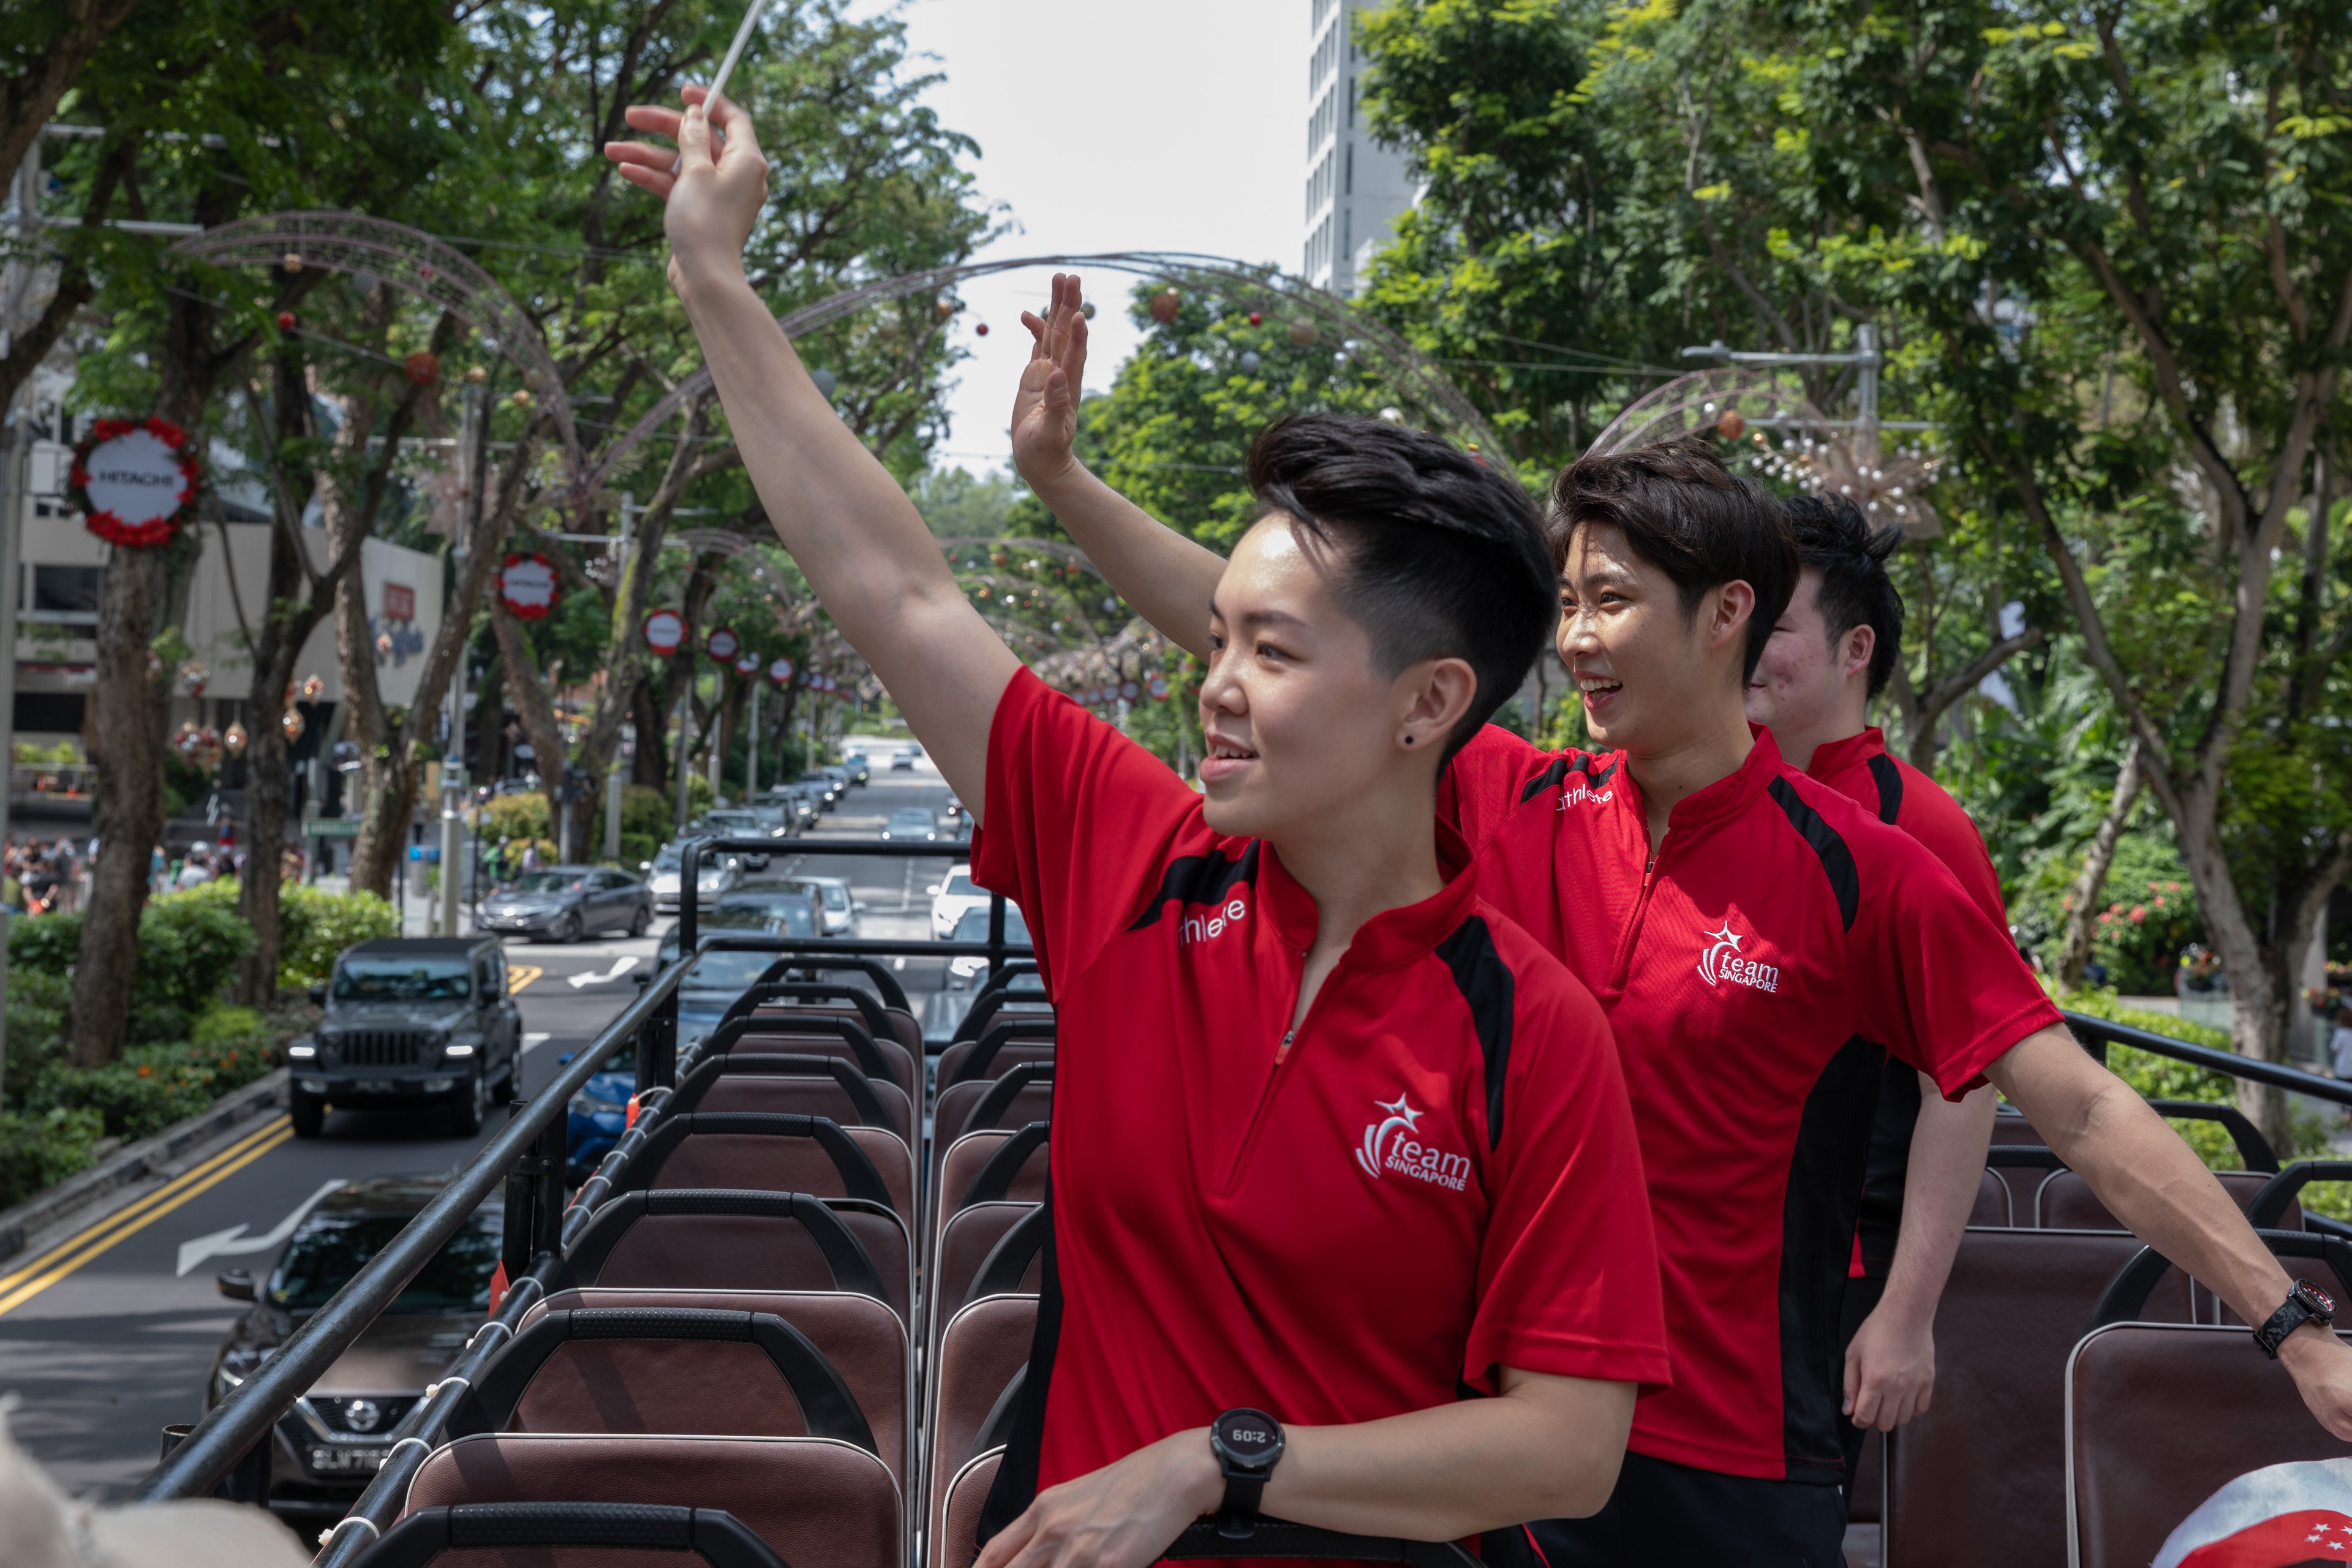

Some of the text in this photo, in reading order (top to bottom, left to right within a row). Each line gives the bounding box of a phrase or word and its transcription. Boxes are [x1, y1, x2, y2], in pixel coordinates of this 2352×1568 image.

[1719, 969, 1777, 993] SINGAPORE
[1722, 951, 1779, 984] team
[1392, 1131, 1471, 1179] team
[1385, 1155, 1466, 1191] SINGAPORE
[1232, 1429, 1266, 1444] 2:09
